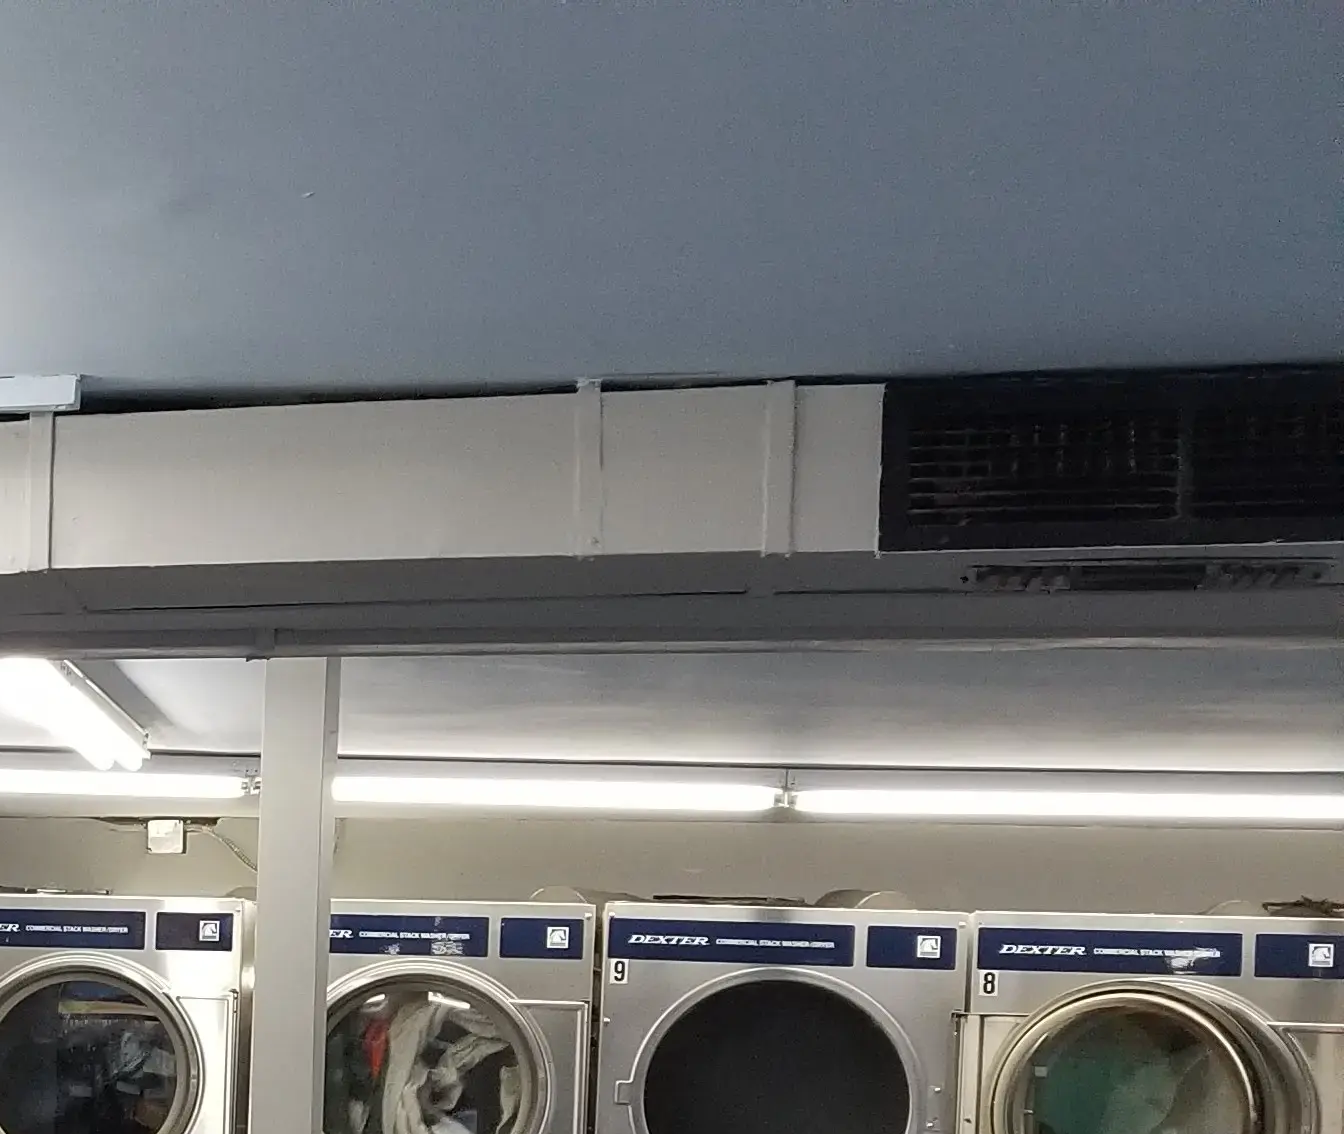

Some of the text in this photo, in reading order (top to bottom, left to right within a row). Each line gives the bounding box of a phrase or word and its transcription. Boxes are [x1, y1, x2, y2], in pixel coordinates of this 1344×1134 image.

[628, 934, 710, 945] DEXTER
[999, 944, 1087, 955] DEXTER
[614, 960, 625, 982] 9
[983, 972, 995, 994] 8
